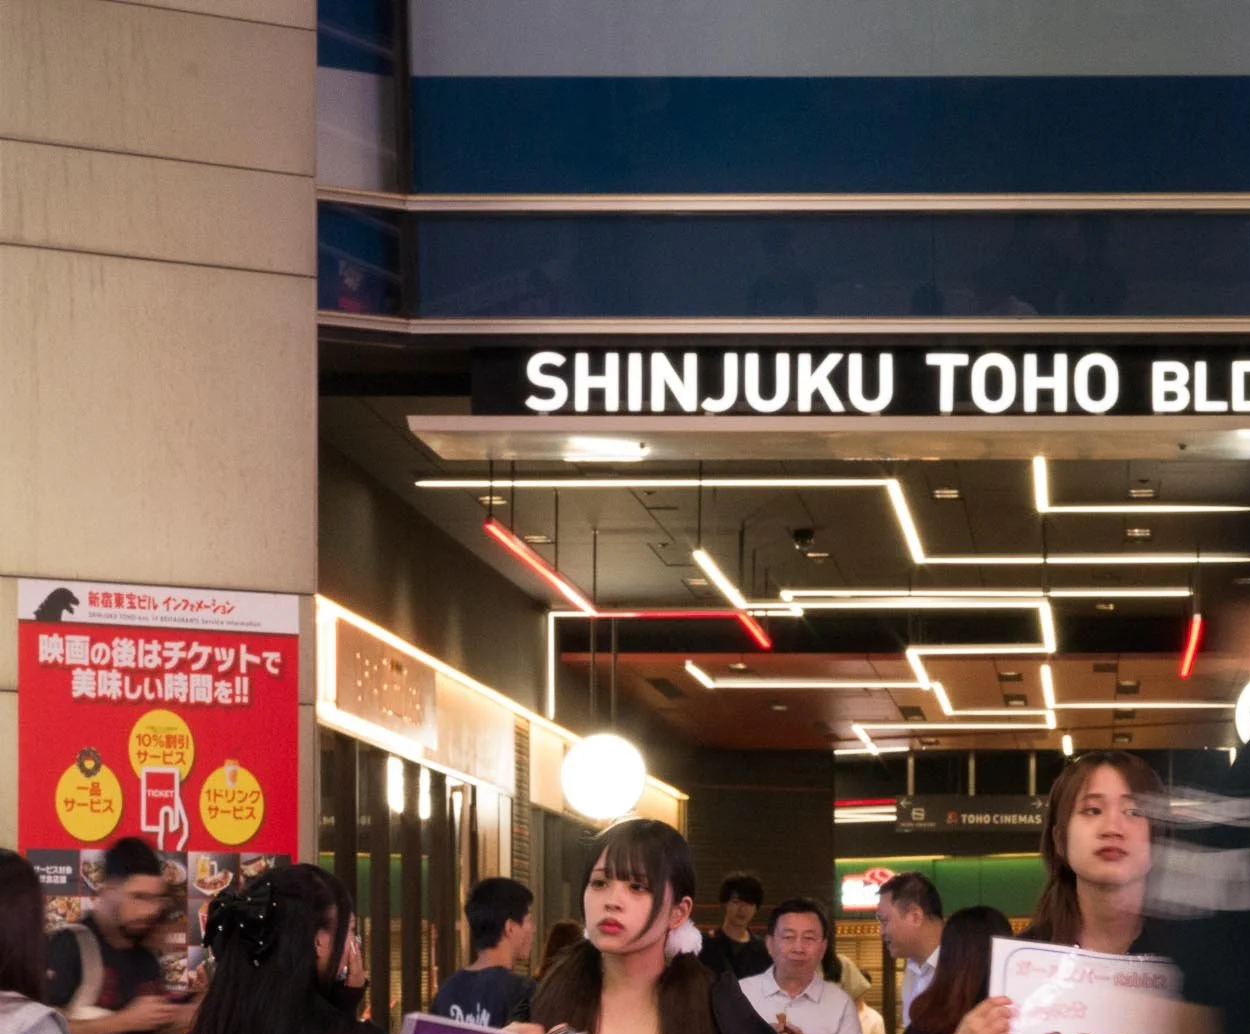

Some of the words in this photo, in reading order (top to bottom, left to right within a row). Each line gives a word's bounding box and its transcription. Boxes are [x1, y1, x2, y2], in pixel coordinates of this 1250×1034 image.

[525, 352, 894, 413] SHINJUKU
[927, 353, 1120, 413] TOHO
[88, 590, 159, 610] 新宿東宝ビル
[162, 594, 236, 615] インフォメーション
[37, 632, 282, 676] 映画の後はチケットで
[136, 733, 190, 750] 10%割引
[137, 750, 187, 766] サービス
[76, 782, 102, 797] 一品
[147, 788, 174, 798] TICKET
[205, 788, 261, 804] 1ドリンク
[64, 797, 114, 814] サービス
[208, 804, 256, 821] サービス
[960, 813, 991, 825] TOHO
[992, 813, 1042, 825] CINEMAS
